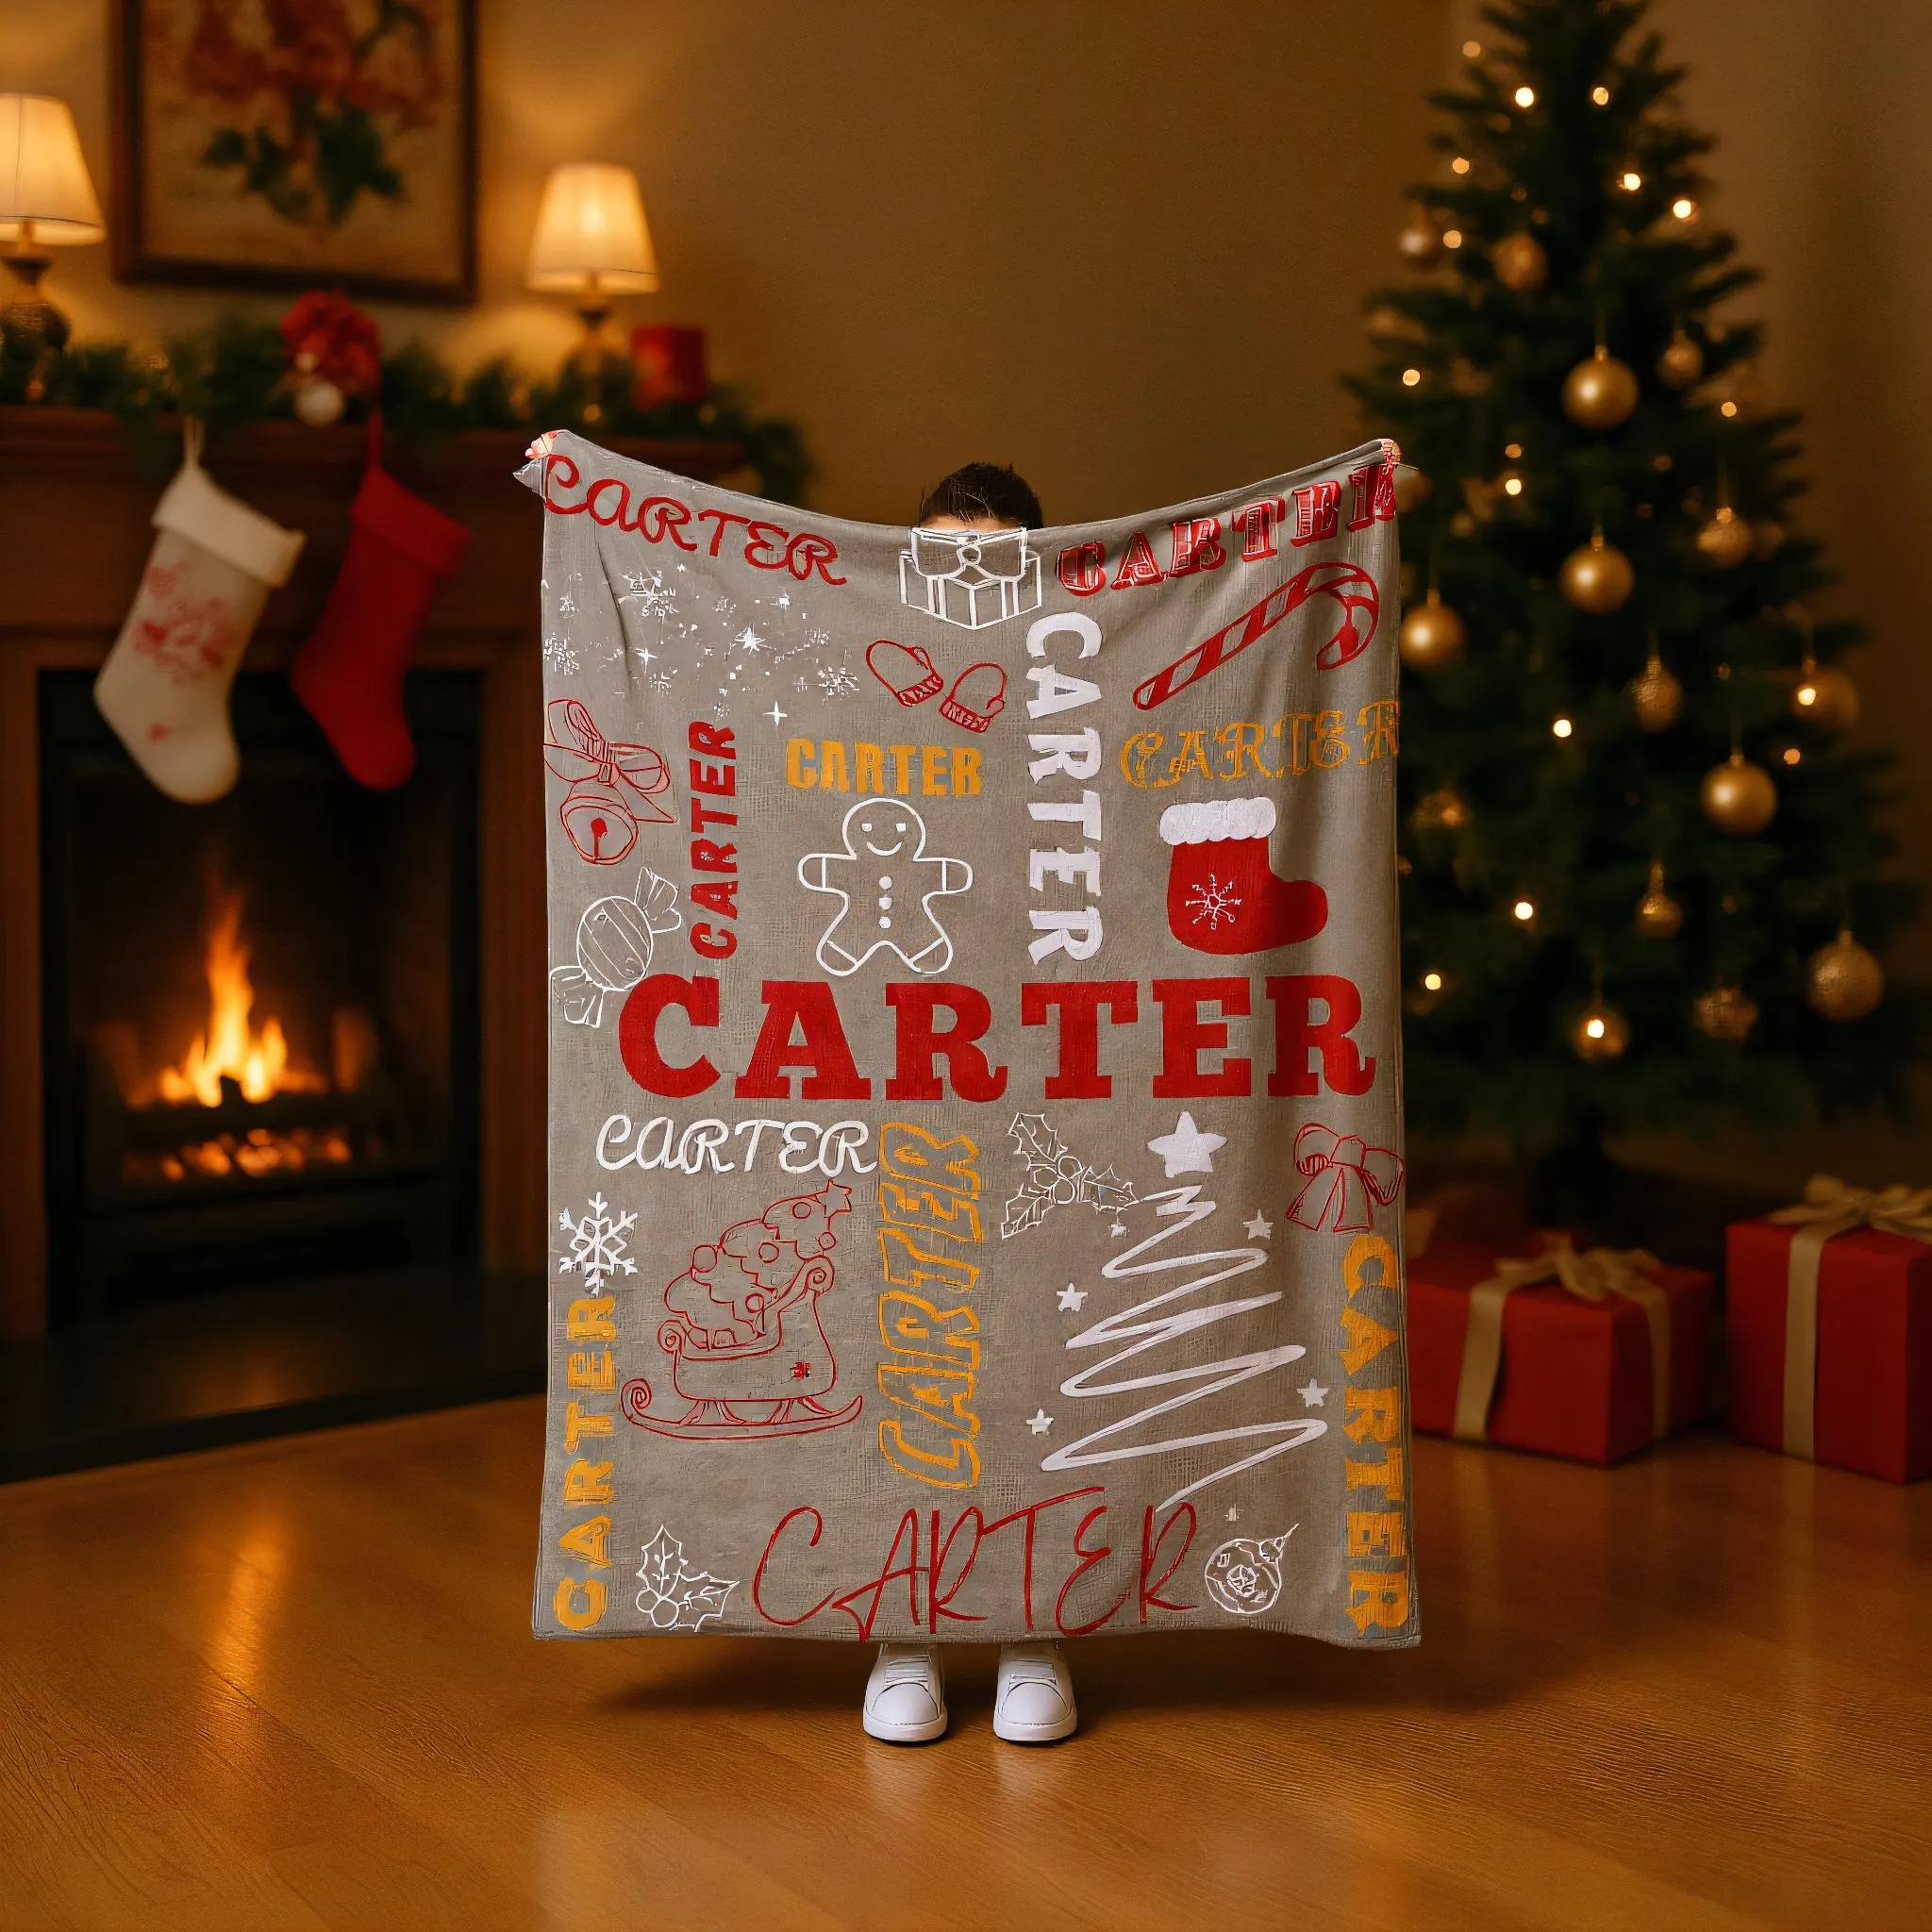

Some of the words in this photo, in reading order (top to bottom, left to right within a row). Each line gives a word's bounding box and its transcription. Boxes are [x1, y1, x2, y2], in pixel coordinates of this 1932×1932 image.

[543, 454, 848, 585] CARTER
[689, 721, 739, 959] CARTER
[785, 738, 983, 796] CARTER
[1025, 611, 1104, 965] CARTER
[618, 973, 1376, 1103] CARTER
[595, 1113, 878, 1175] CARTER
[877, 1122, 984, 1489] CARTER
[554, 1295, 616, 1630] CARTER
[1340, 1235, 1409, 1637] CARTER
[752, 1486, 1200, 1643] CARTER
